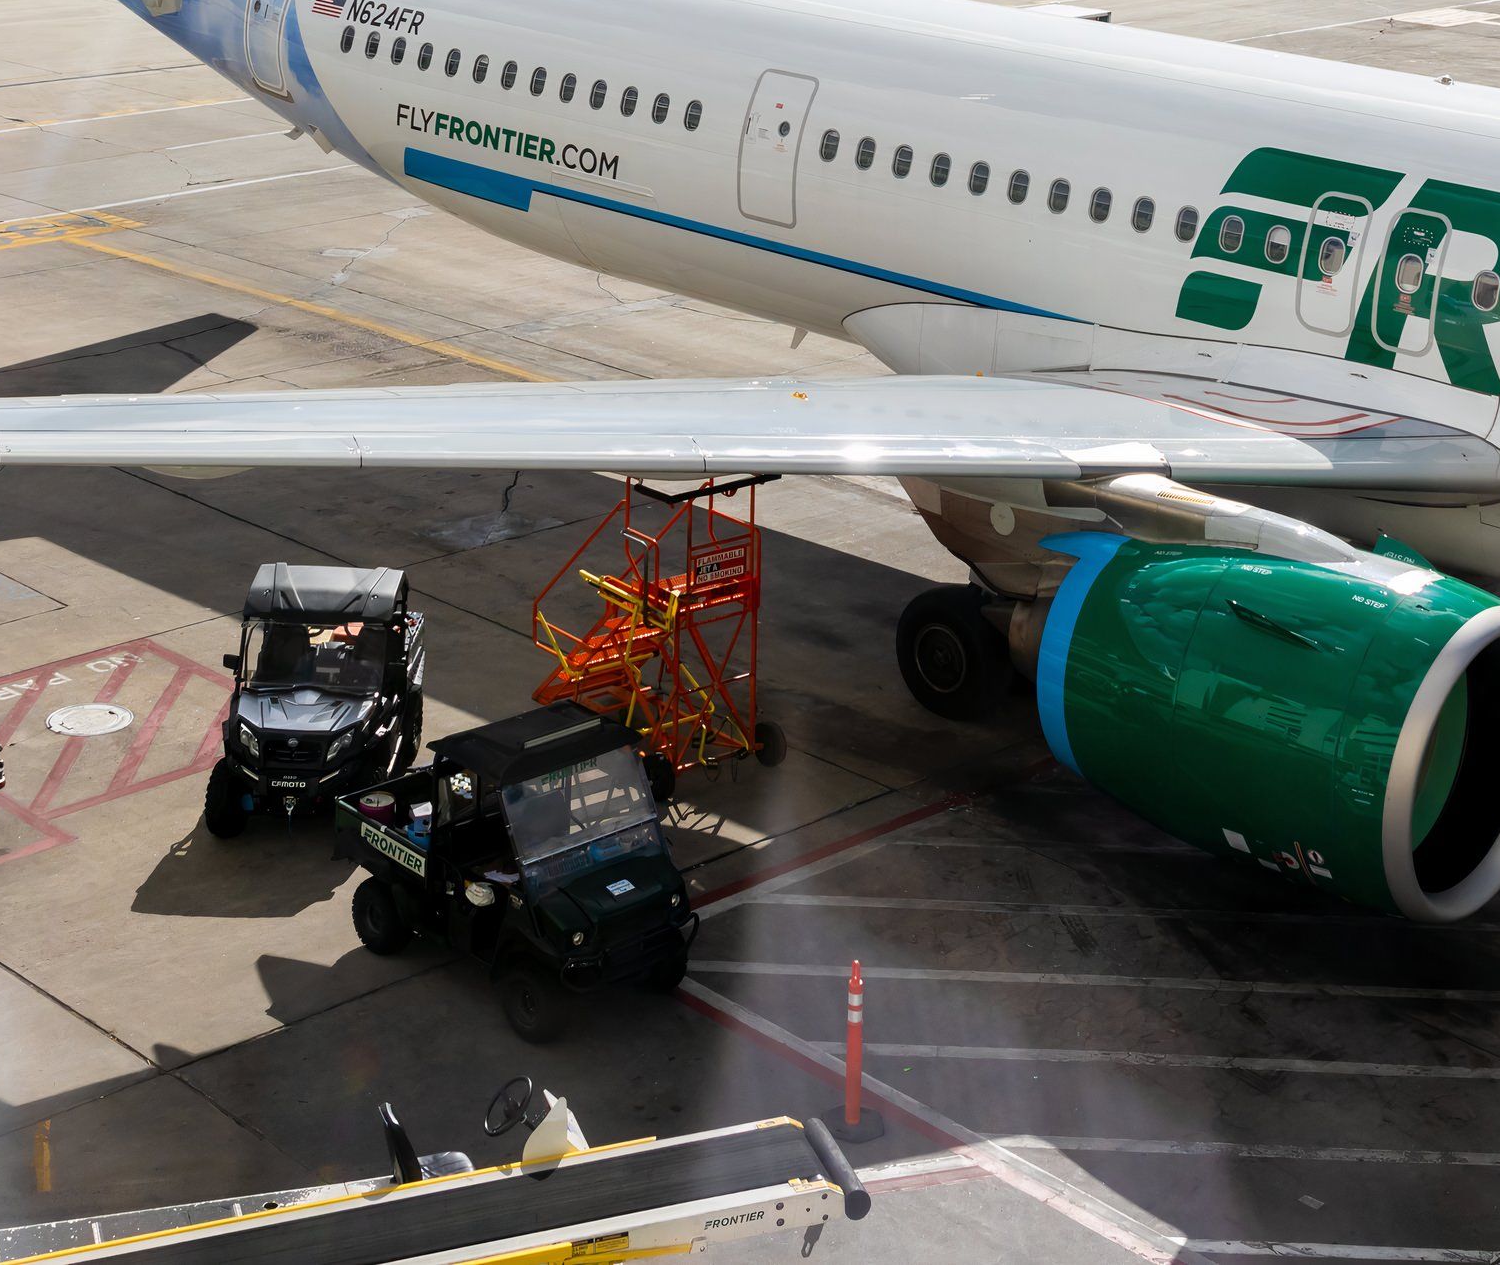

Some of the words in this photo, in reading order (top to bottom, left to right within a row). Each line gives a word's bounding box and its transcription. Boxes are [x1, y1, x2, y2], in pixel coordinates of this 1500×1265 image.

[396, 103, 620, 180] FLYFRONTIER.COM
[697, 549, 743, 565] FLAMMABLE
[1241, 564, 1253, 572] NO
[697, 574, 708, 582] NO
[1351, 594, 1364, 603] NO
[1364, 598, 1386, 609] STEP
[271, 780, 306, 788] CFMOTO
[364, 826, 423, 873] FRONTIER
[703, 1210, 765, 1231] FRONTIER
